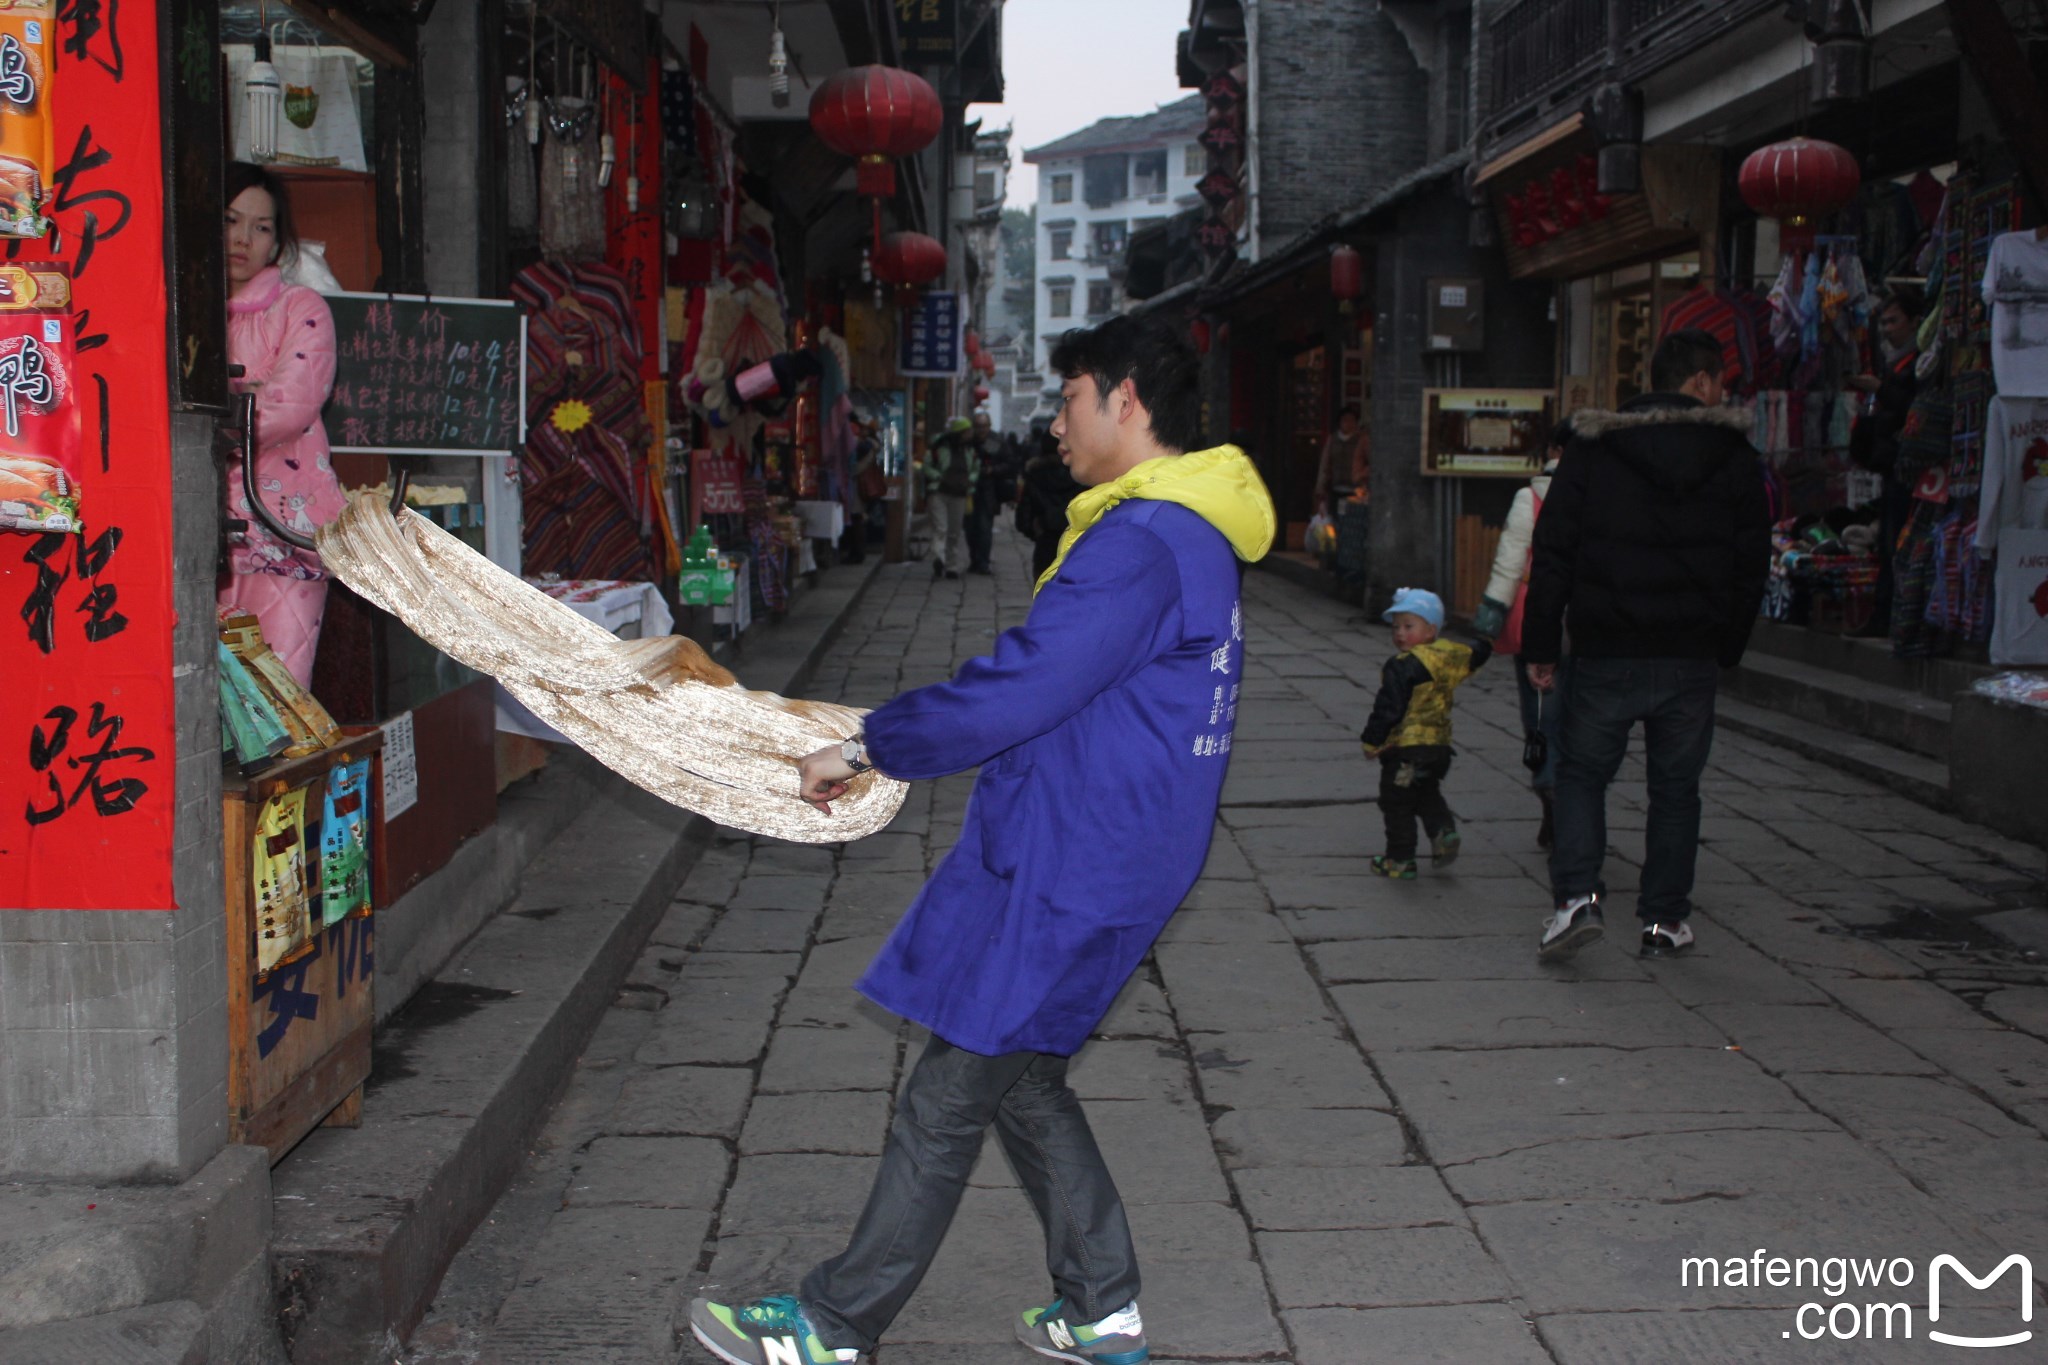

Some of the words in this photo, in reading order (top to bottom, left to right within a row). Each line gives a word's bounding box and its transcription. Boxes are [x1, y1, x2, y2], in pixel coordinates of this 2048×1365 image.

[703, 481, 740, 510] 5元
[1047, 1318, 1077, 1350] N
[761, 1336, 803, 1365] N
